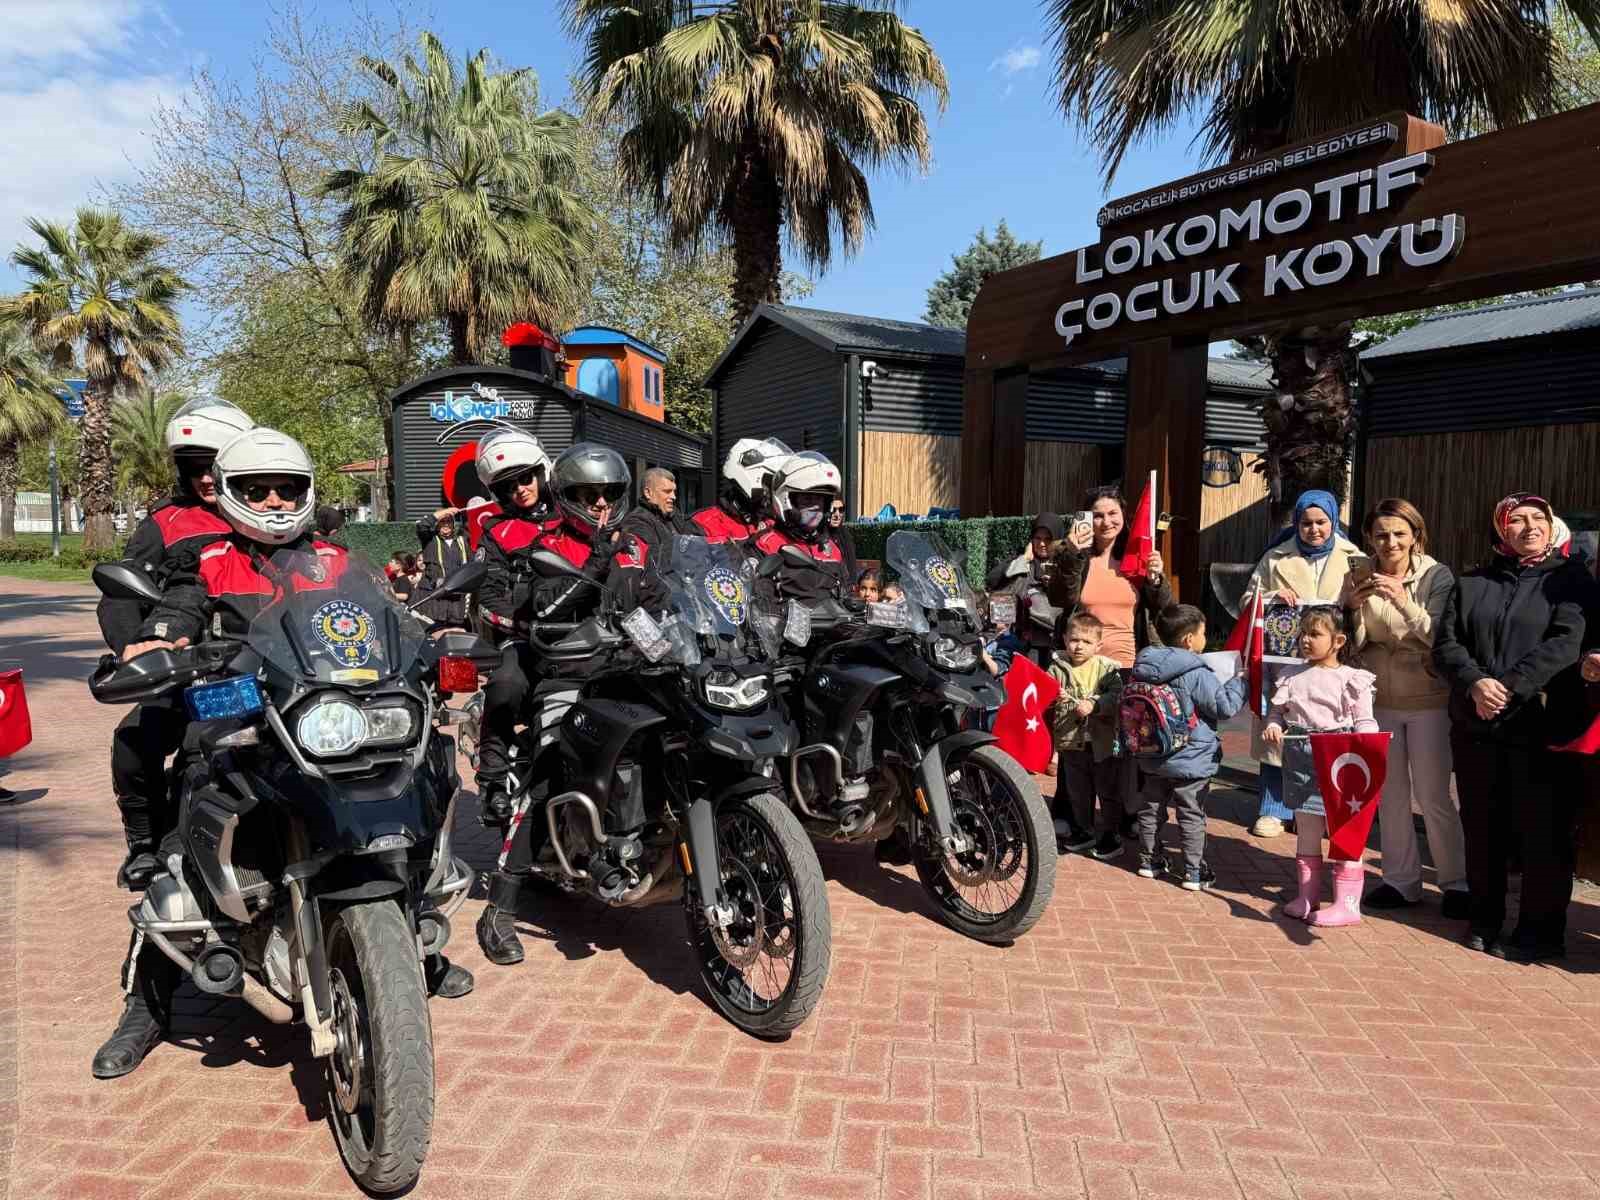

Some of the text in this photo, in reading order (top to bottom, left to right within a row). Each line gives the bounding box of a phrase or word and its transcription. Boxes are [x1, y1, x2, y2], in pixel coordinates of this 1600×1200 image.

[1054, 213, 1462, 347] ÇOCUK KÖYÜ
[1075, 152, 1435, 284] LOKOMOTİF
